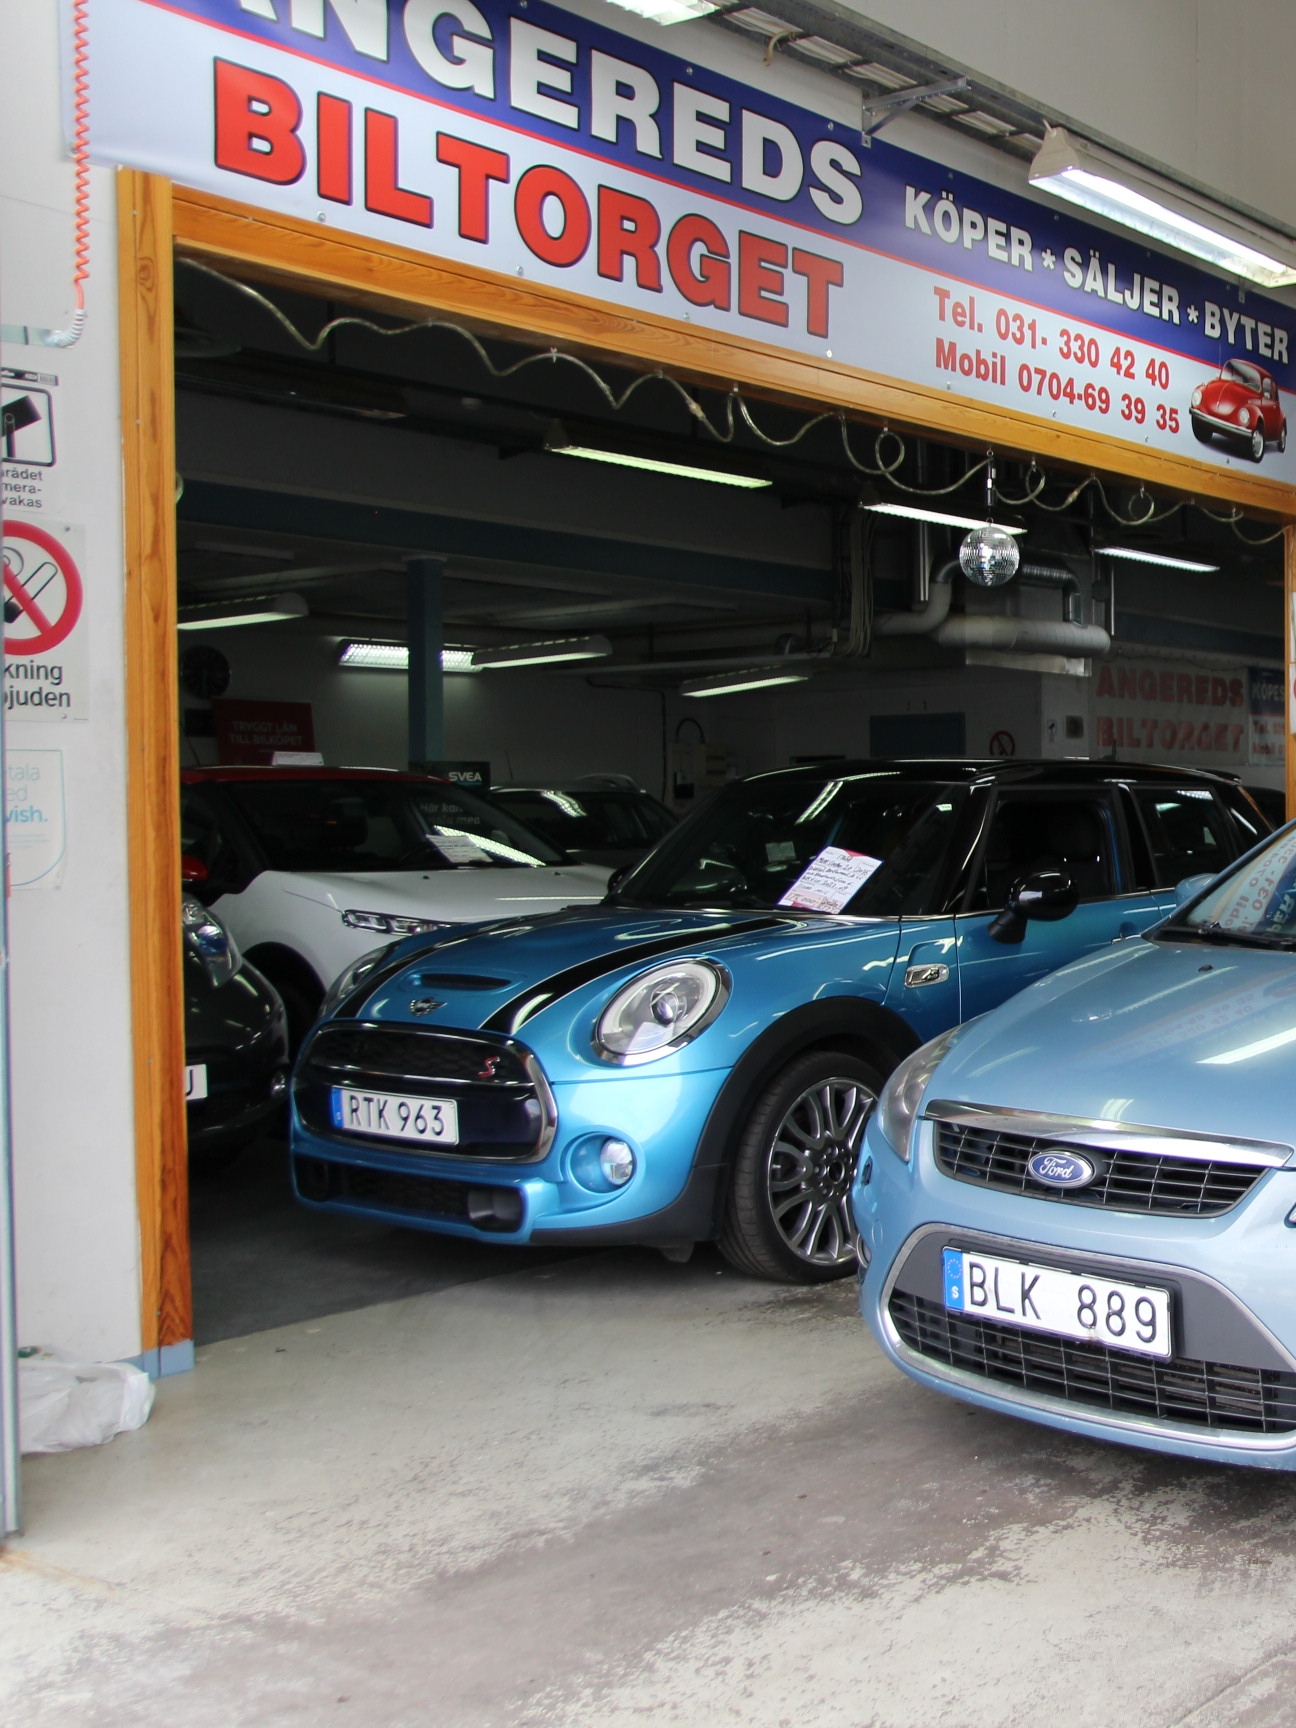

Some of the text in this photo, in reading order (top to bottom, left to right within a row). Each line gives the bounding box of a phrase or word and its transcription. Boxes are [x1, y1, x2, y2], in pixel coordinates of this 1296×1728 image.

[241, 0, 864, 226] GEREDS
[212, 56, 844, 339] BILTORGET
[905, 185, 1290, 365] KÖPER SÄLJER BYTER
[933, 285, 1171, 390] Tel. 031- 330 42 40
[935, 337, 1180, 434] Mobil 0704-69 39 35
[2, 466, 43, 481] rådet
[4, 685, 71, 710] juden
[1096, 665, 1244, 708] ANGEREDS
[231, 720, 271, 733] TRYGGT
[1096, 716, 1244, 752] BILTORGET
[448, 771, 482, 782] SVEA
[349, 1094, 446, 1137] RTK 963
[1039, 1154, 1073, 1180] Ford
[951, 1285, 960, 1299] S
[968, 1261, 1158, 1344] BLK 889
